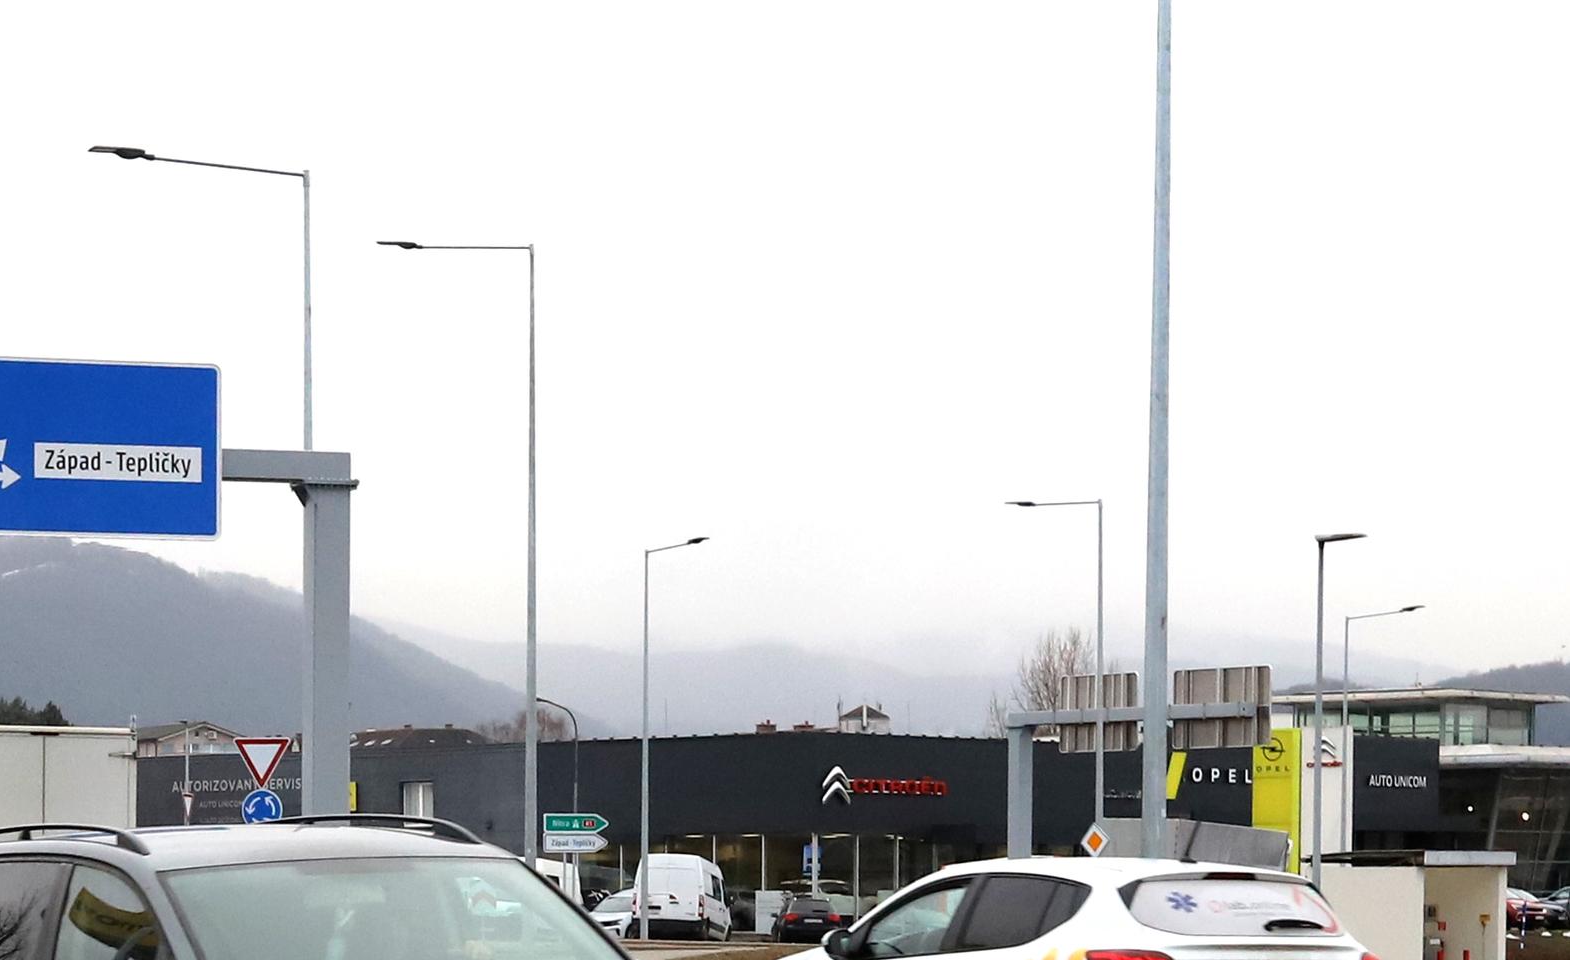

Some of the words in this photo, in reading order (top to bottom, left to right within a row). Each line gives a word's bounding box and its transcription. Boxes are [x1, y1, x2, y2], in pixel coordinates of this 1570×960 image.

[44, 449, 101, 475] Západ
[116, 452, 191, 478] Tepličky
[1191, 767, 1253, 784] OPEL
[1369, 774, 1392, 787] AUTO
[1394, 775, 1427, 788] UNICOM
